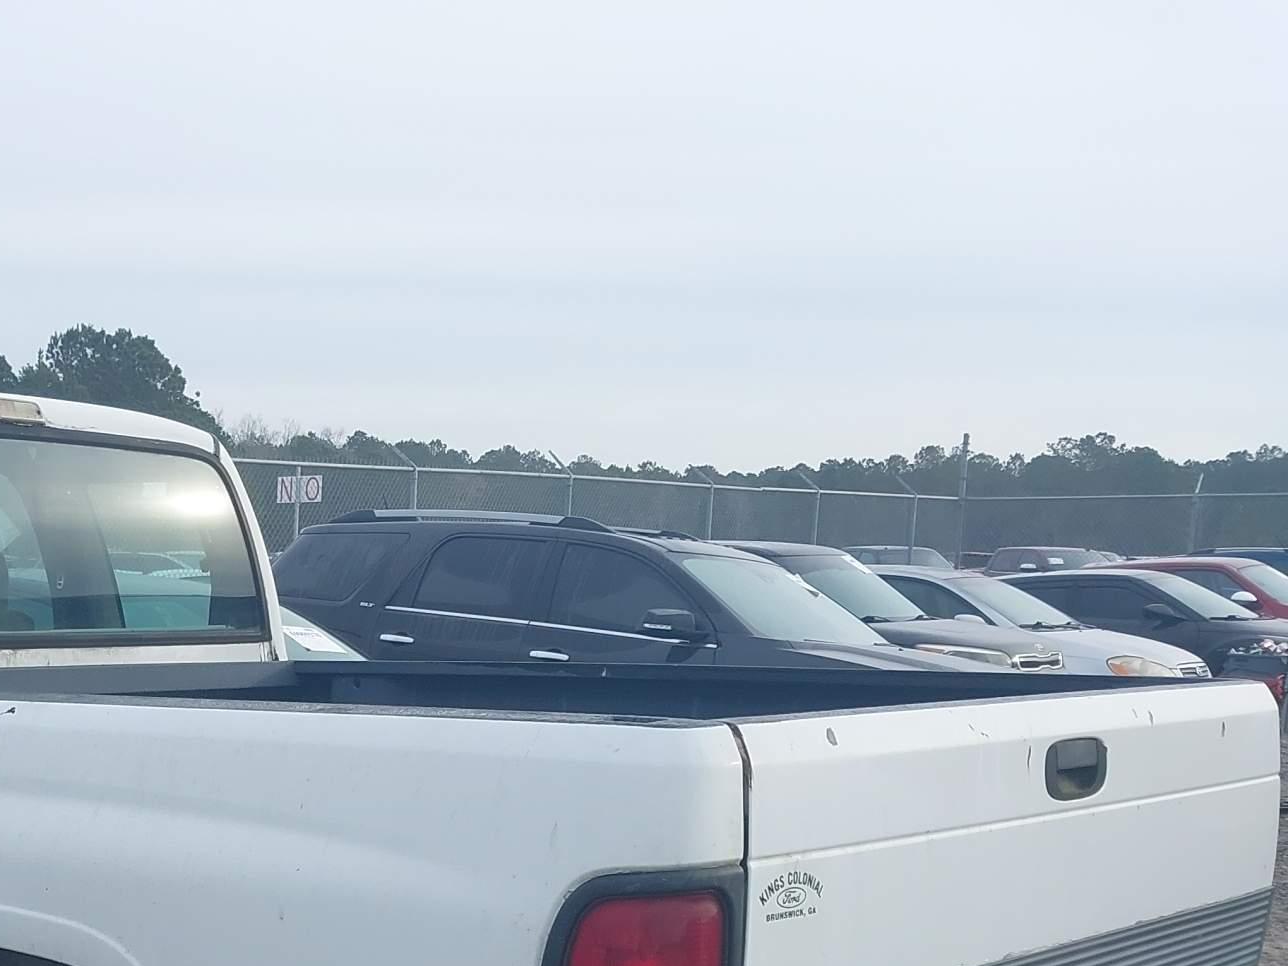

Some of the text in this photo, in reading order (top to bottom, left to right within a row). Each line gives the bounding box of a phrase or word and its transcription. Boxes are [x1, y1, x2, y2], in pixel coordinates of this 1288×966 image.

[759, 871, 824, 906] KINGS COLONIAL
[782, 890, 802, 905] Ford
